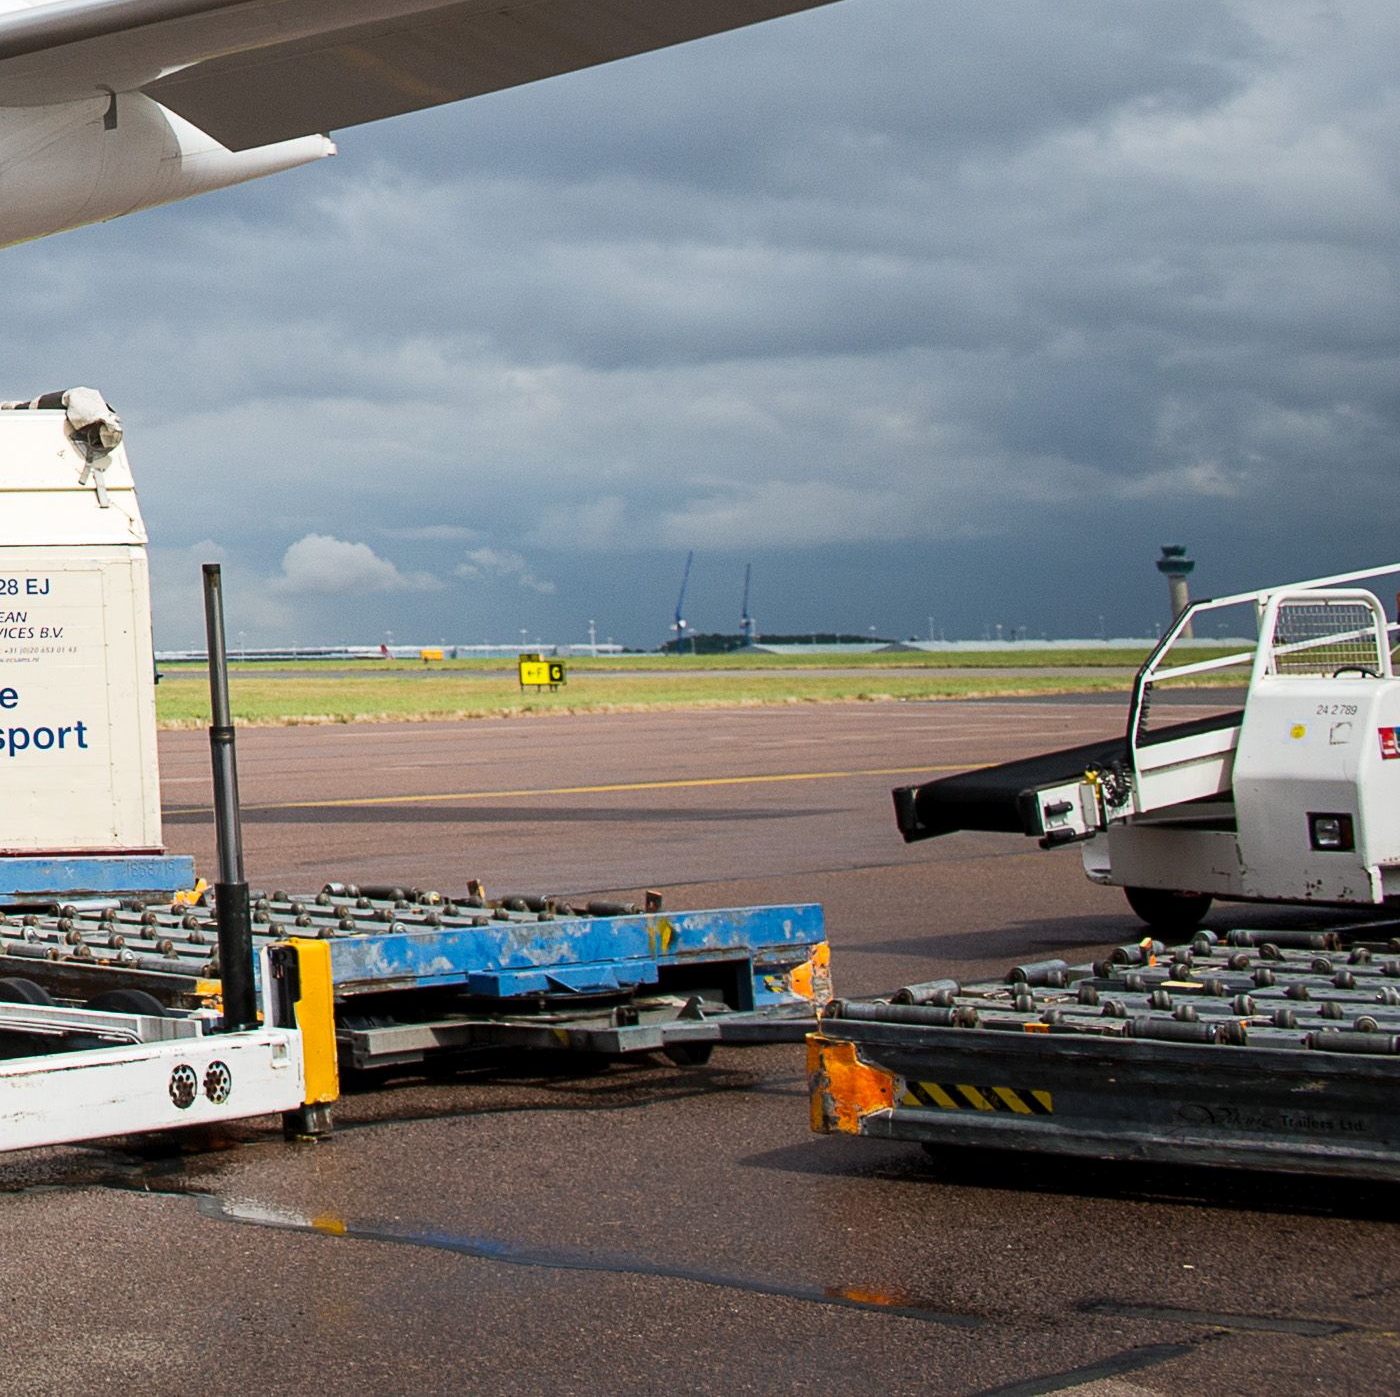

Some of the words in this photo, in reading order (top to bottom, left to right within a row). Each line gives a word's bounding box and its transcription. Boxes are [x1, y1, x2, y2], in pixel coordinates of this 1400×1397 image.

[26, 578, 50, 595] EJ
[40, 627, 64, 639] B.V.
[552, 666, 561, 679] G
[1340, 704, 1358, 715] 789
[1280, 1115, 1334, 1130] Trailers
